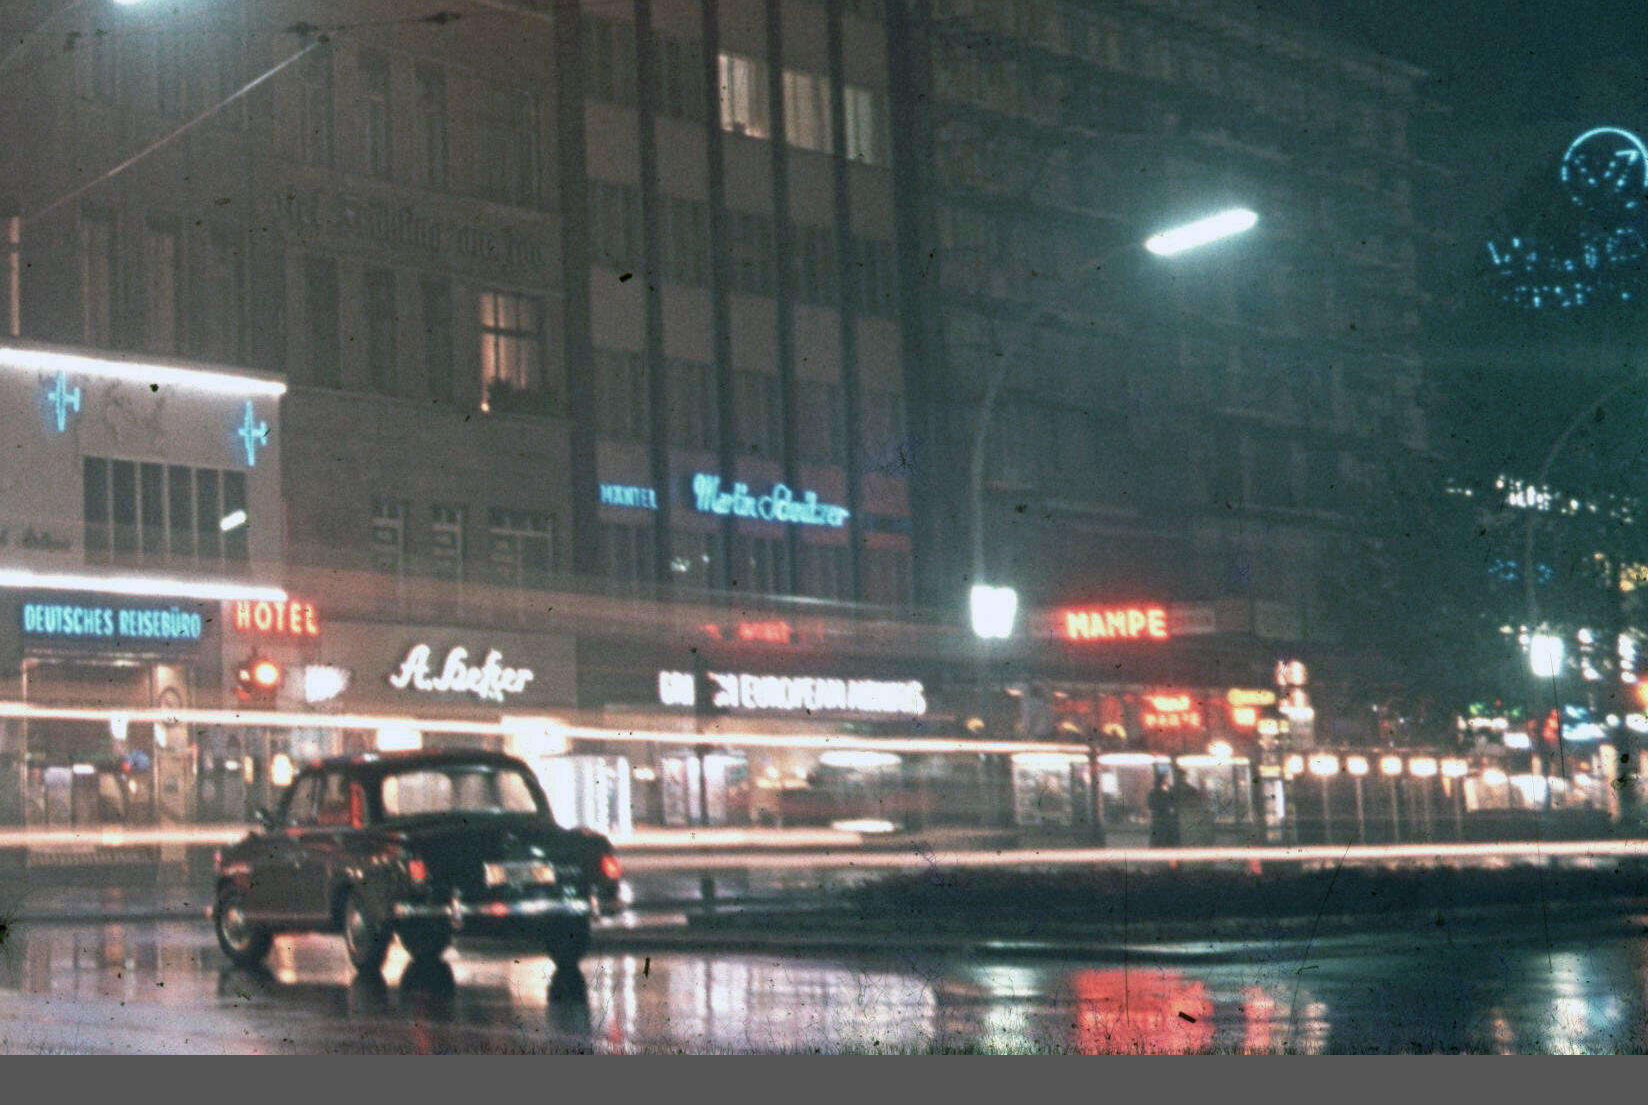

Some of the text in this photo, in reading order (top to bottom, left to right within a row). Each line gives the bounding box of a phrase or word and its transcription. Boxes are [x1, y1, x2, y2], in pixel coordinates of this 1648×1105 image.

[23, 603, 202, 640] DEUTSCHES REISEBÜRO
[236, 598, 320, 637] HOTEL
